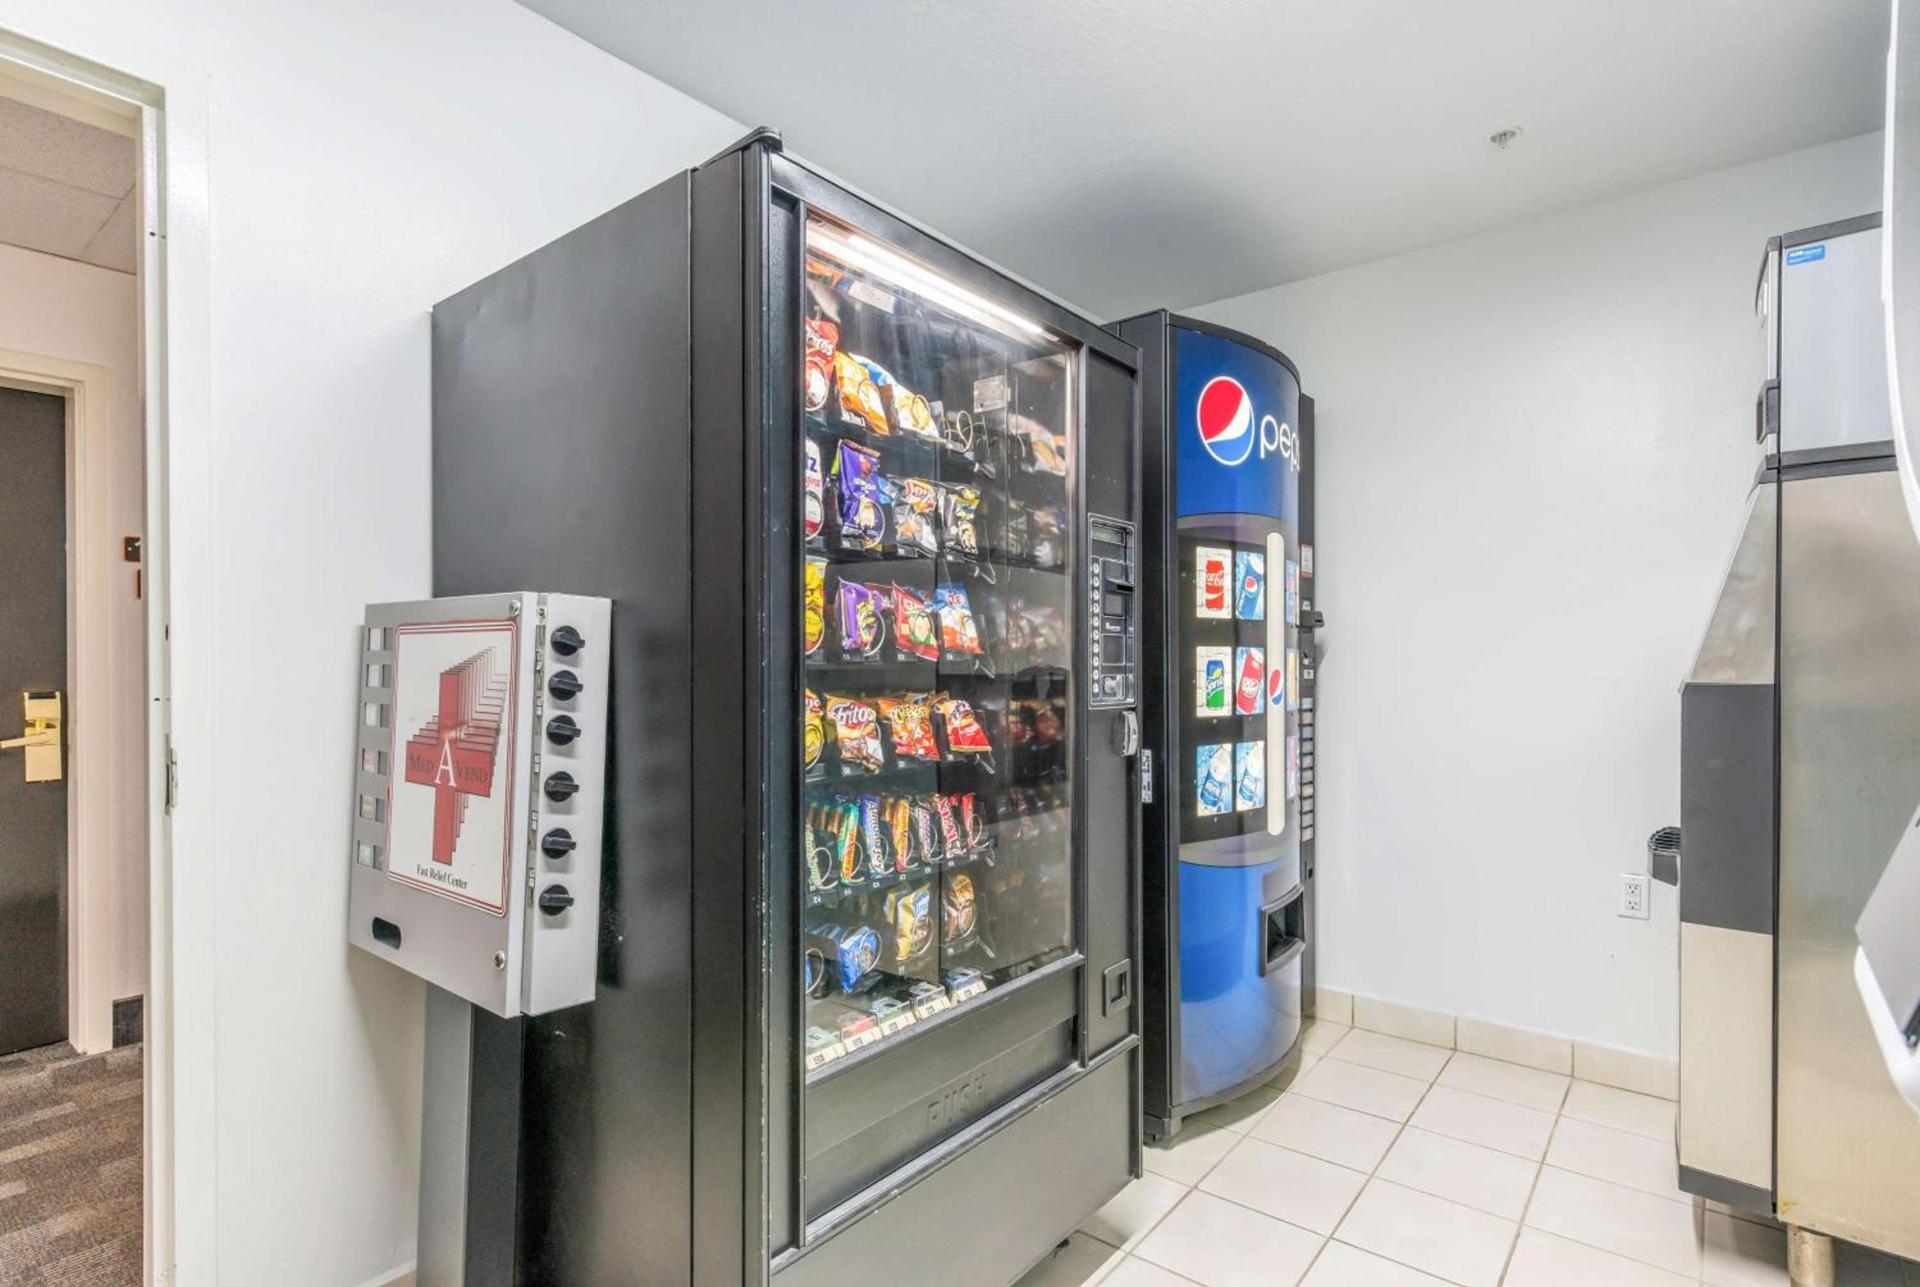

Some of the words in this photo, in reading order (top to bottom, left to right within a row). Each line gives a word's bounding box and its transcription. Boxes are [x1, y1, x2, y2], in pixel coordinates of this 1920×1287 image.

[1260, 415, 1300, 472] pep
[833, 702, 876, 725] Fritos
[416, 863, 429, 878] Fast
[429, 867, 448, 883] Relief
[447, 872, 468, 890] Center
